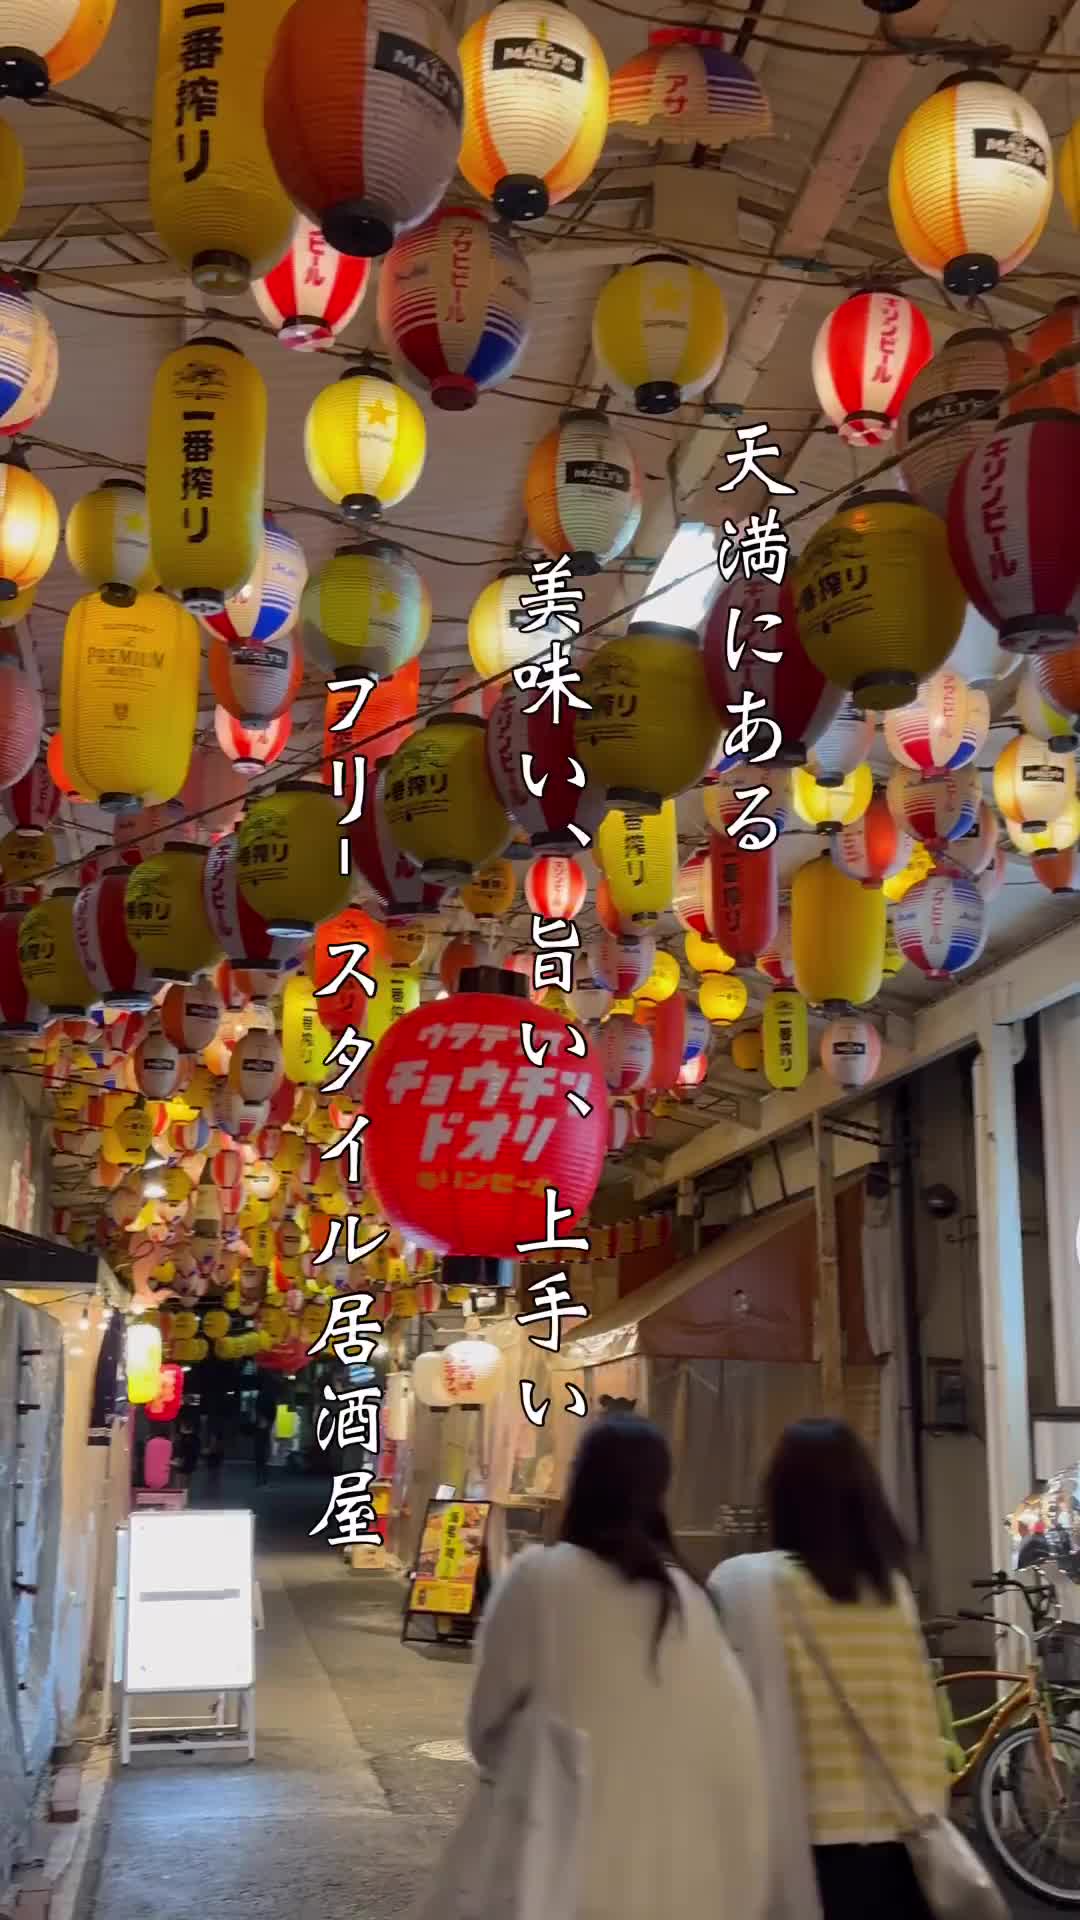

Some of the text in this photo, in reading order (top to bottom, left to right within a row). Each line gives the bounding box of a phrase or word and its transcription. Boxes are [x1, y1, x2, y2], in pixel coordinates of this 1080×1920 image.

[175, 3, 225, 183] 一番搾り
[871, 297, 900, 384] キリンビール
[181, 410, 217, 544] 一番搾り
[981, 436, 1018, 581] キリンビール
[419, 1112, 557, 1163] ドオリ
